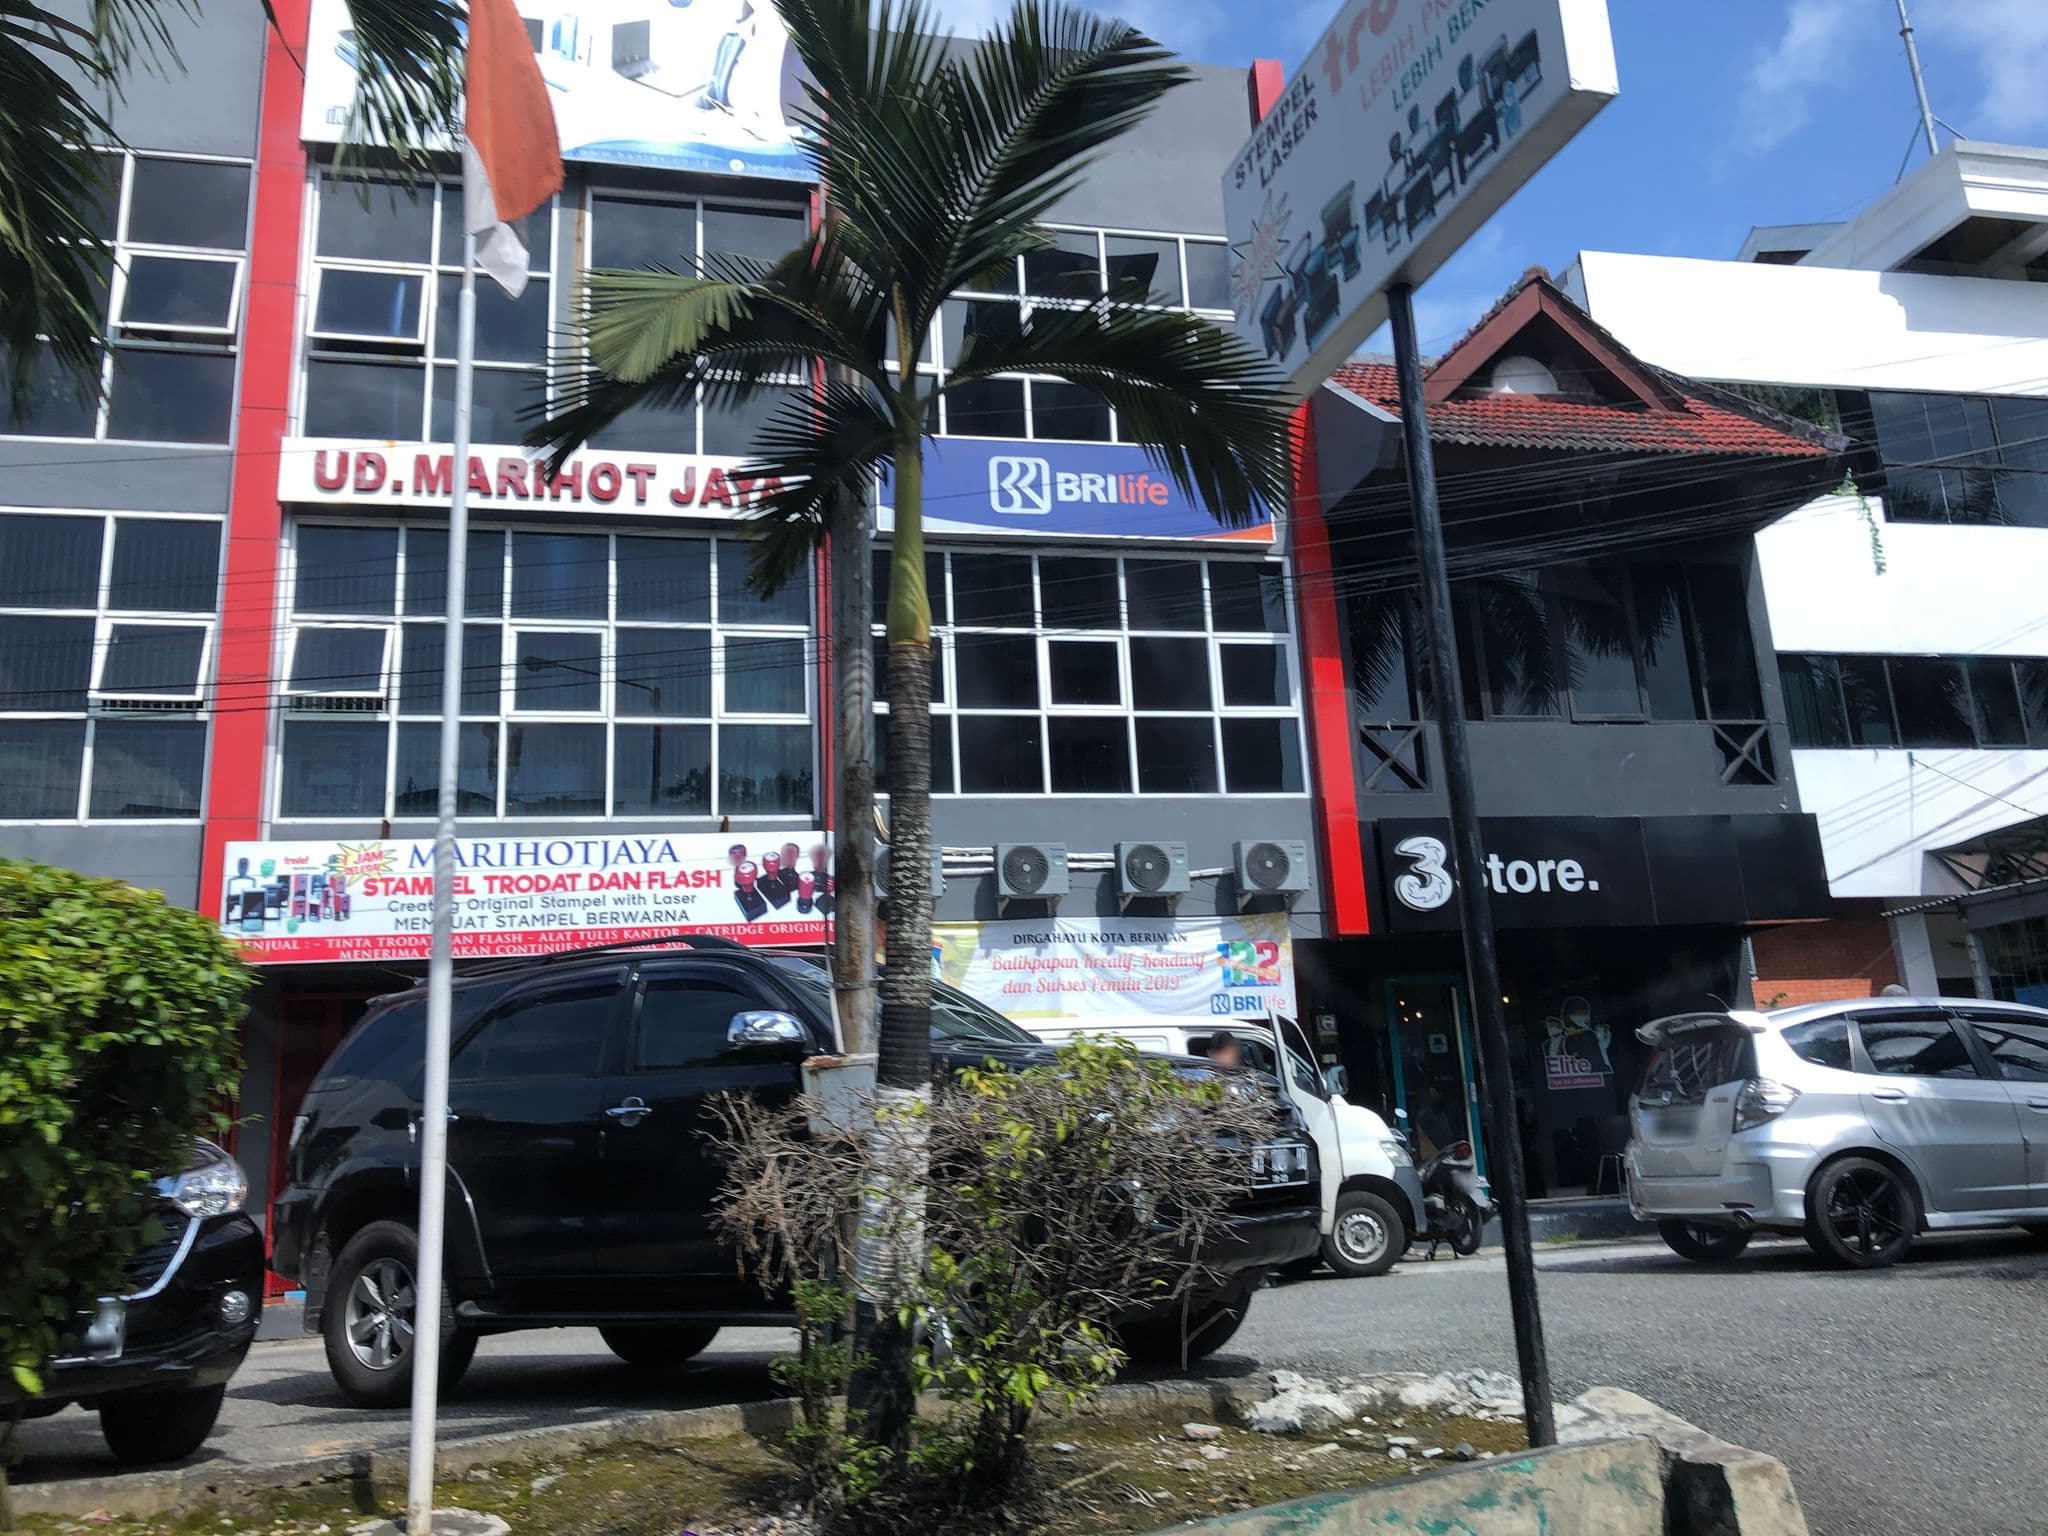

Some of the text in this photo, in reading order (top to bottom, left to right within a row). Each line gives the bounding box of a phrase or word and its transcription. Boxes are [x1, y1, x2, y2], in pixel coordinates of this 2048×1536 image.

[1392, 0, 1488, 112] LEBIH BER
[1235, 73, 1315, 191] STEMPEL
[1260, 98, 1319, 189] LASER
[362, 869, 721, 897] STAMEL TRODAT DAN FLASH
[1455, 852, 1600, 895] tore.
[387, 893, 697, 914] Creatg Original Stampel with Laser
[394, 909, 691, 931] MEMUAT STAMPEL BERWARNA
[243, 938, 300, 952] ENJUAL
[325, 937, 372, 949] TINTA
[452, 934, 473, 945] AN
[479, 933, 523, 944] FLASH
[538, 931, 574, 943] ALAT
[579, 929, 618, 940] TULIS
[623, 927, 680, 939] KANTOR
[694, 924, 765, 936] CATRIDGE
[1013, 932, 1188, 944] DIRGAHAYU KOTA BERIMAN
[339, 946, 420, 960] MENERIMA
[424, 946, 490, 958] CAKAN
[1002, 979, 1032, 994] dan
[1036, 977, 1087, 994] Sukses
[1090, 976, 1141, 992] Pemilu
[1546, 1056, 1591, 1074] Elite
